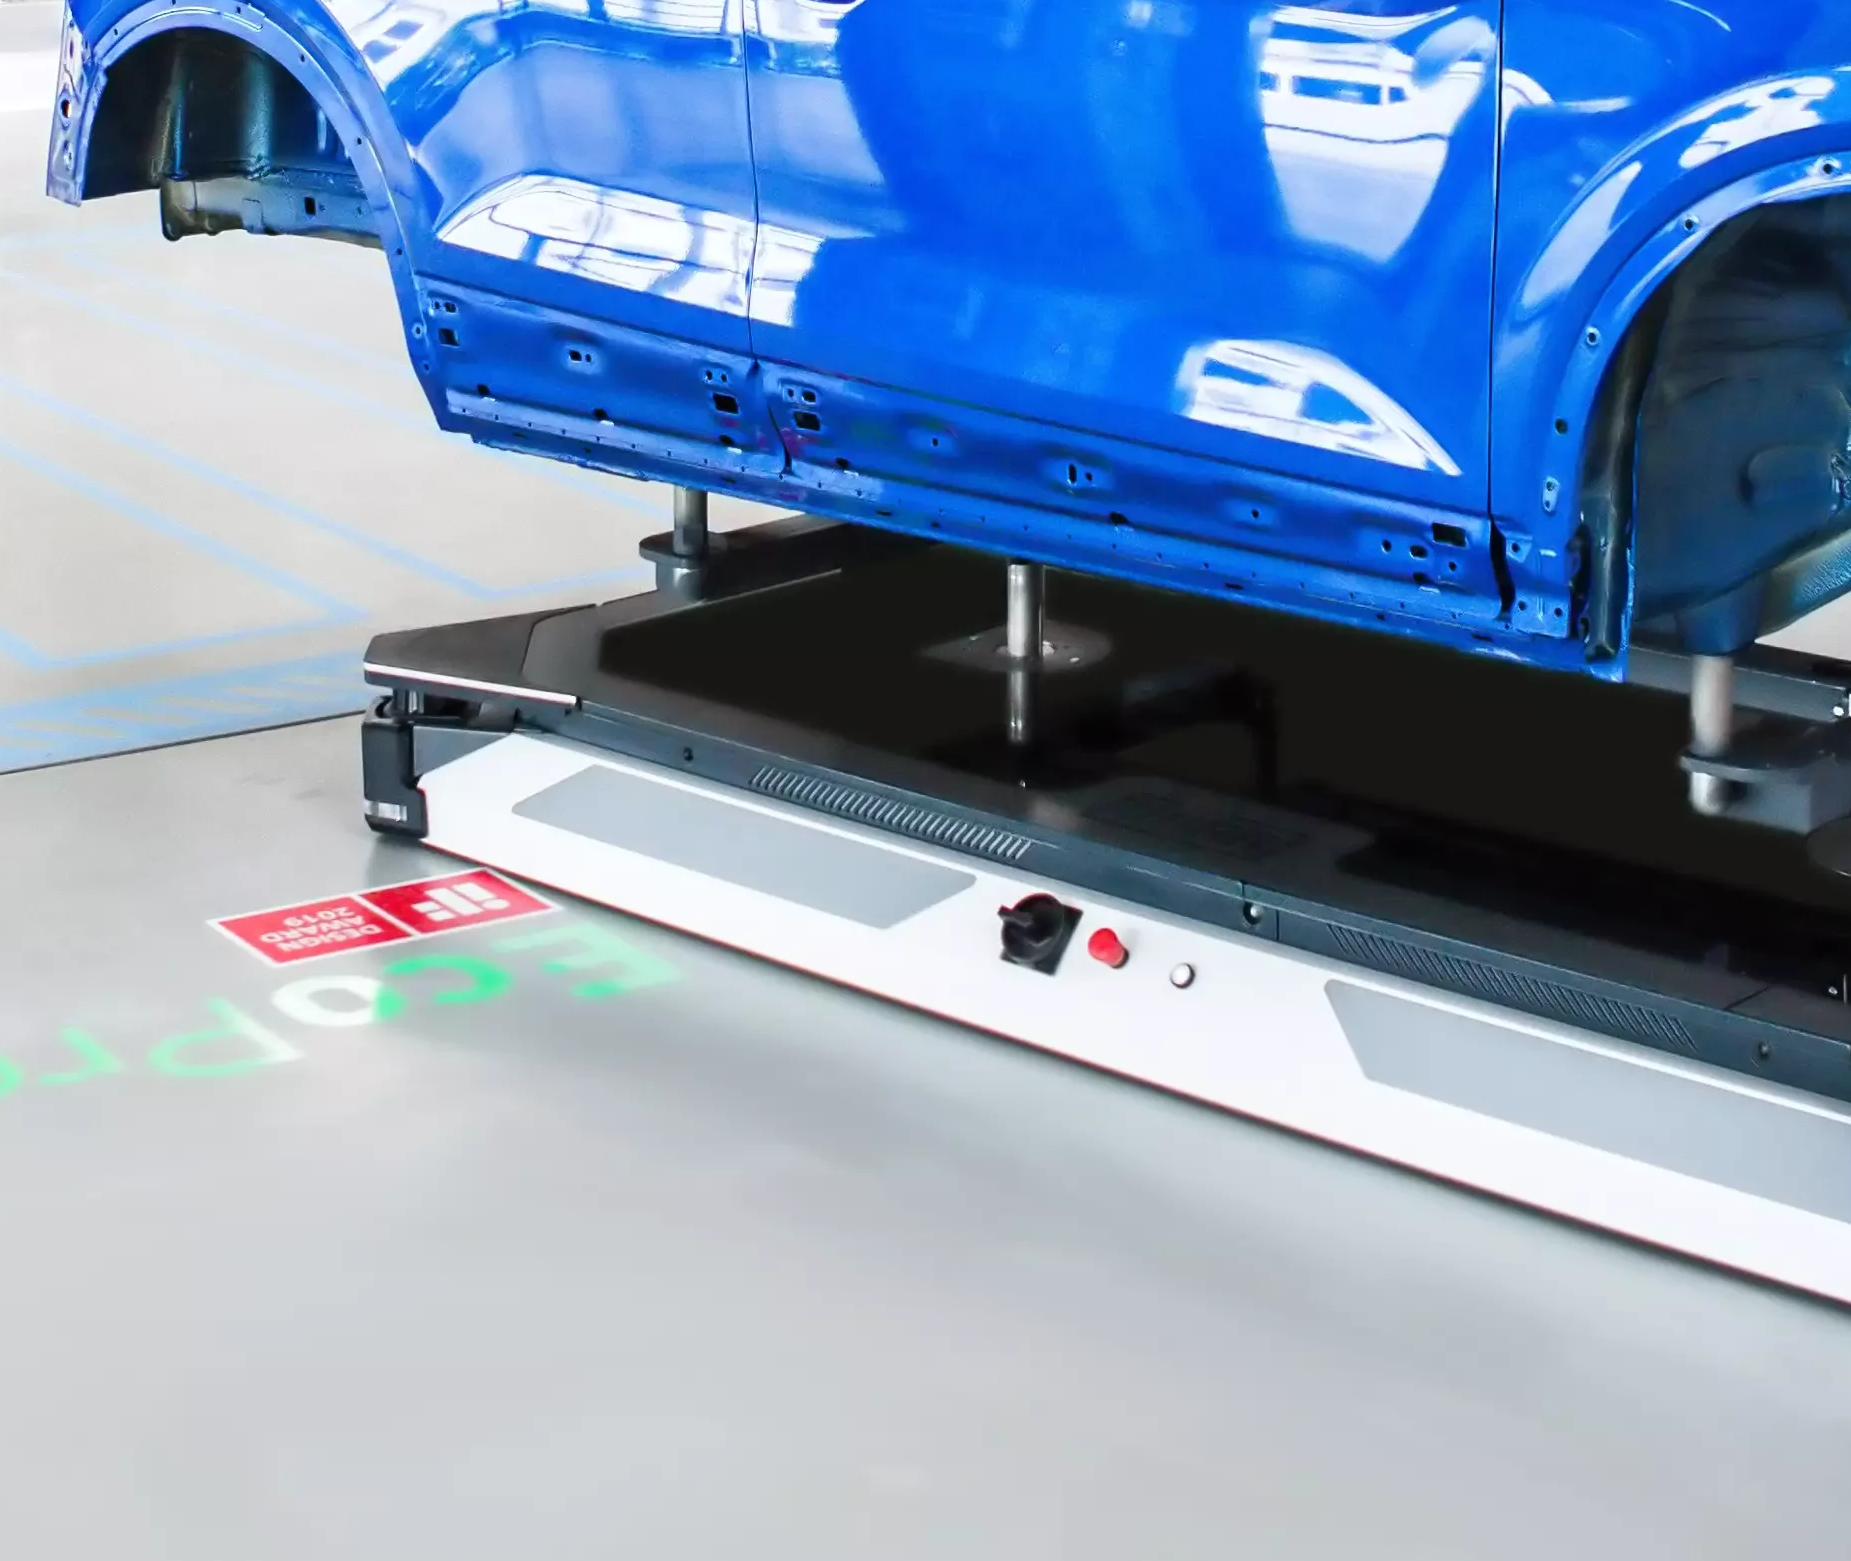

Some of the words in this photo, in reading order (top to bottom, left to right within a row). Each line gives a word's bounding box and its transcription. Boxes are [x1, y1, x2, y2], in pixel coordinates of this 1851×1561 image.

[260, 914, 366, 944] AWARD
[284, 905, 357, 928] 2019
[276, 923, 385, 953] DESIGN
